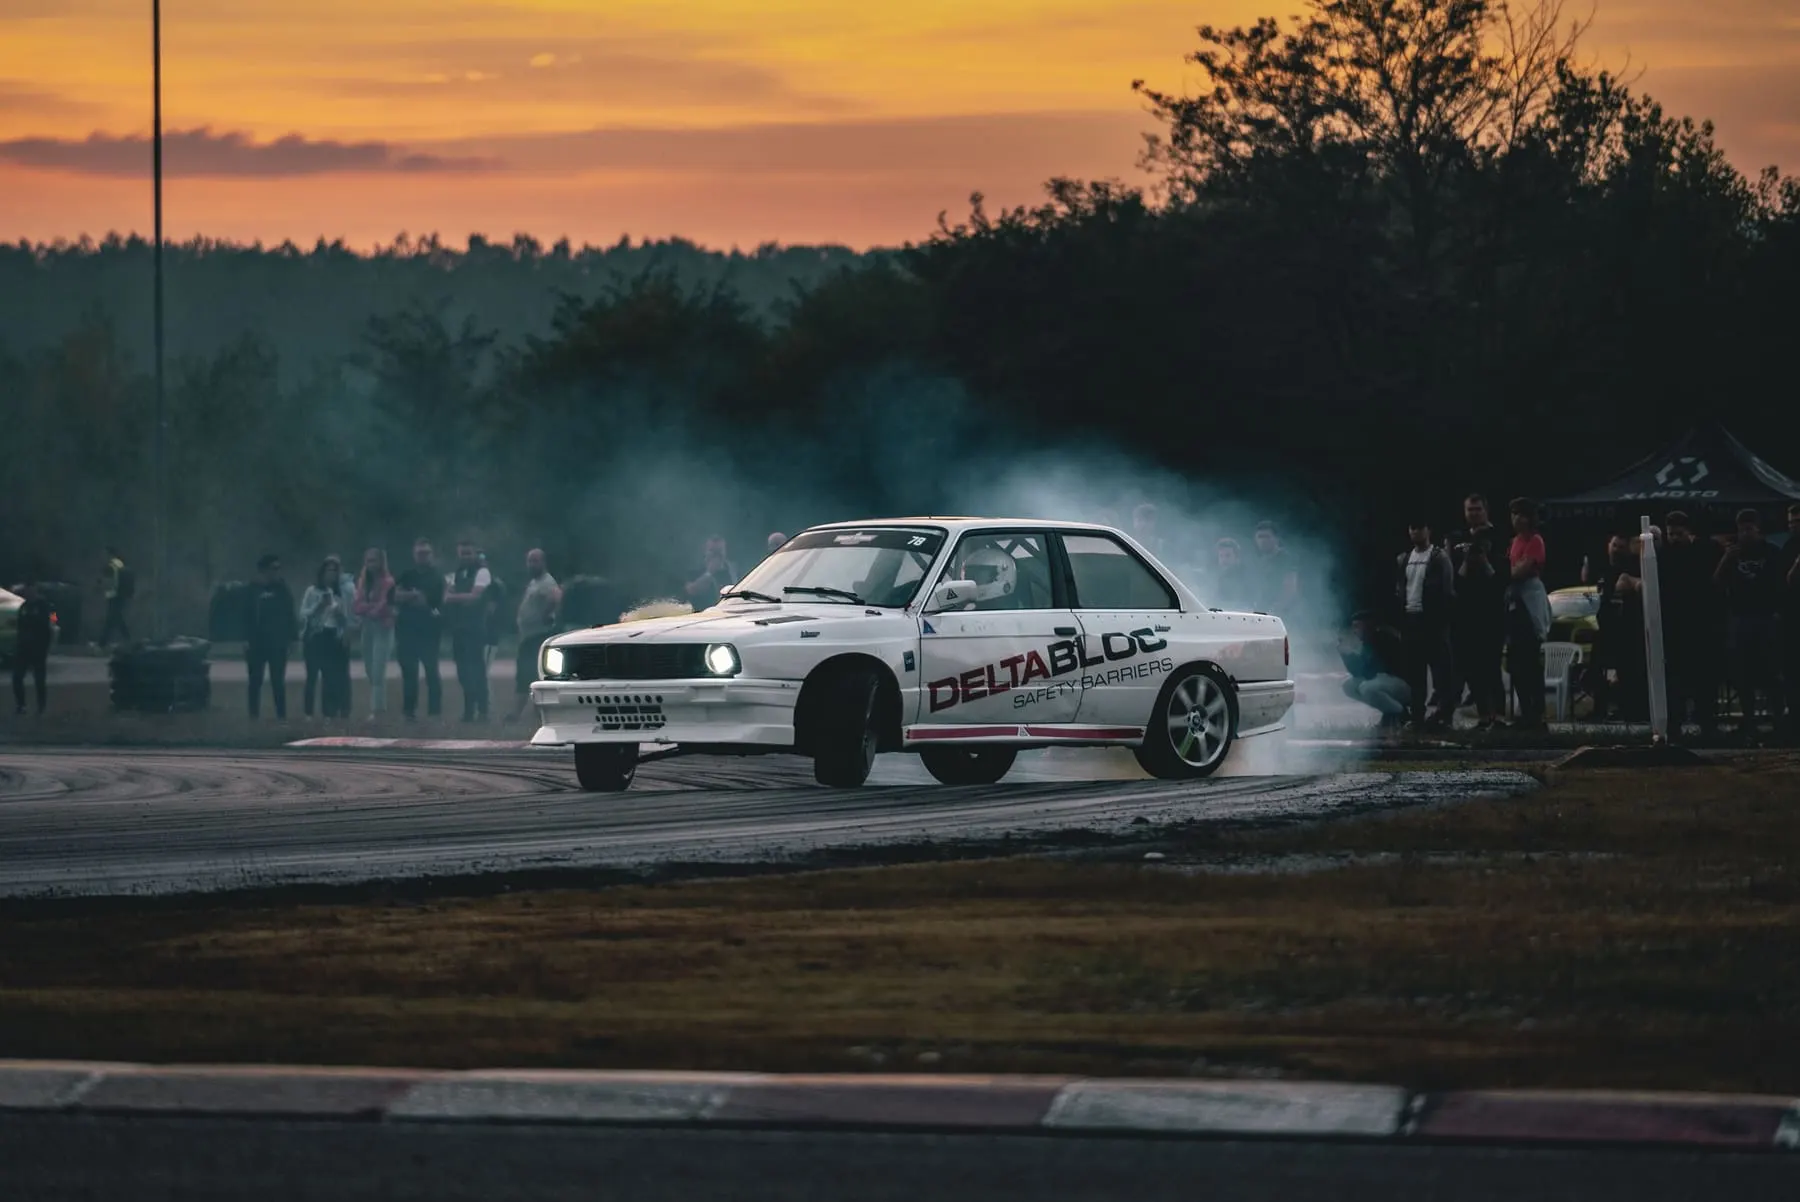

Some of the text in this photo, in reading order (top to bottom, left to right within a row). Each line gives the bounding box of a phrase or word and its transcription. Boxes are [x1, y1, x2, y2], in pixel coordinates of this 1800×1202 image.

[1618, 490, 1719, 500] XLMOTO
[1013, 657, 1174, 709] SAFETY BARRIERS
